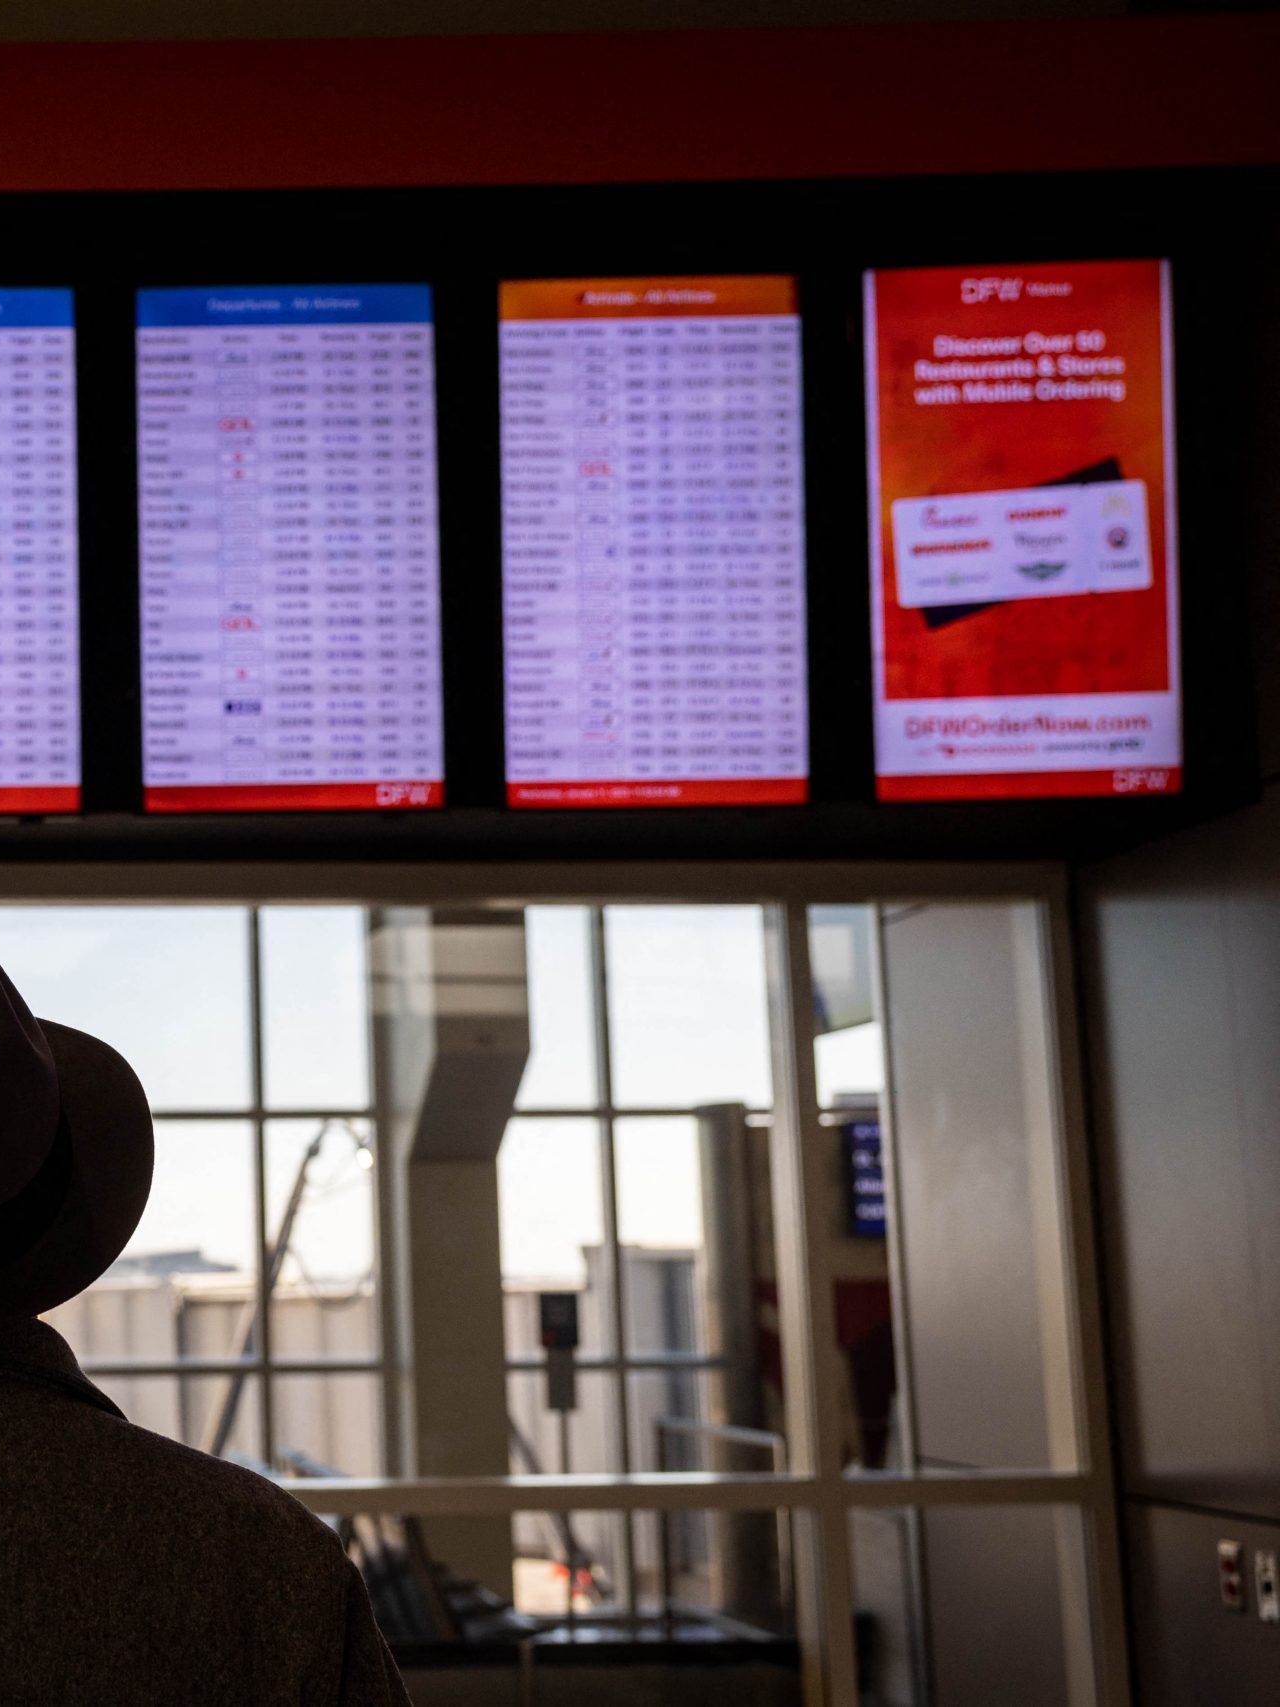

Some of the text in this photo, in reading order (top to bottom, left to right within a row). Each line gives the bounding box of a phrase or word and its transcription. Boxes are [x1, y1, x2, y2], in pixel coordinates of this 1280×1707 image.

[962, 278, 1022, 302] DFW
[934, 335, 1022, 357] Discover
[1024, 331, 1072, 354] Over
[915, 354, 1125, 381] Restaurants & Stores
[914, 377, 1126, 405] with Mobile Ordering
[905, 712, 1151, 739] DFWOrderNow.com
[1112, 769, 1170, 792] DFW
[376, 784, 431, 806] DFW
